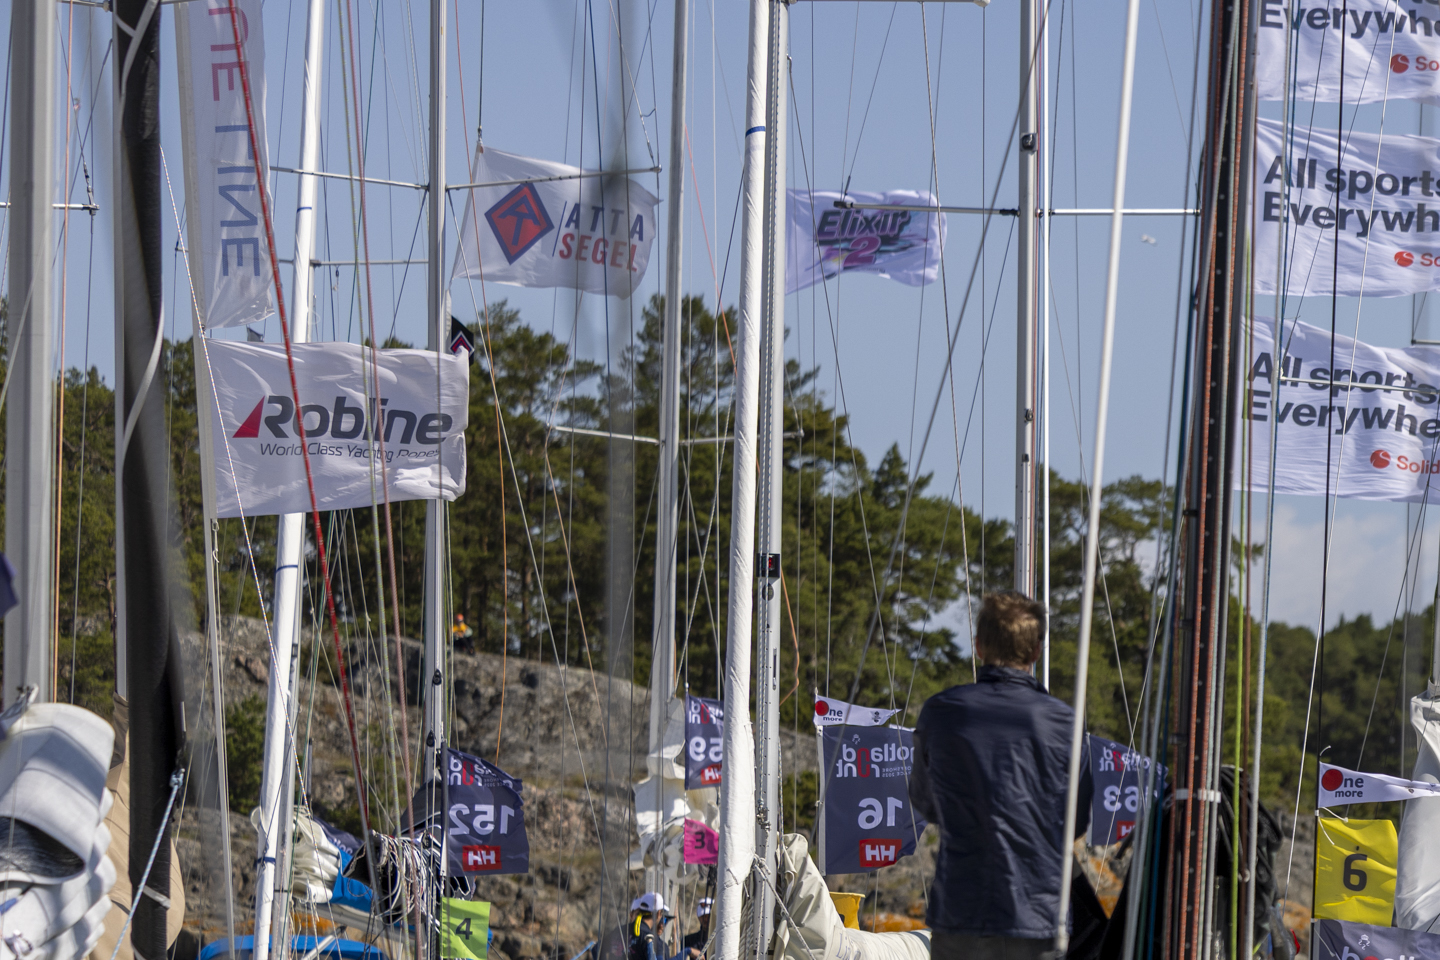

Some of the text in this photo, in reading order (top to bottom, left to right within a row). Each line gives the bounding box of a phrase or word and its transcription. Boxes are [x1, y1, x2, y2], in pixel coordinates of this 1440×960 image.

[1263, 155, 1317, 189] All
[565, 203, 644, 242] ATTA
[817, 209, 911, 245] Elixir
[559, 232, 638, 273] SEGEL
[843, 235, 882, 270] 2
[1247, 352, 1303, 384] All
[264, 395, 453, 444] Robline
[307, 442, 343, 456] Class
[1334, 790, 1363, 798] more
[694, 831, 706, 849] 3
[1343, 853, 1368, 892] 6
[455, 917, 473, 940] 4
